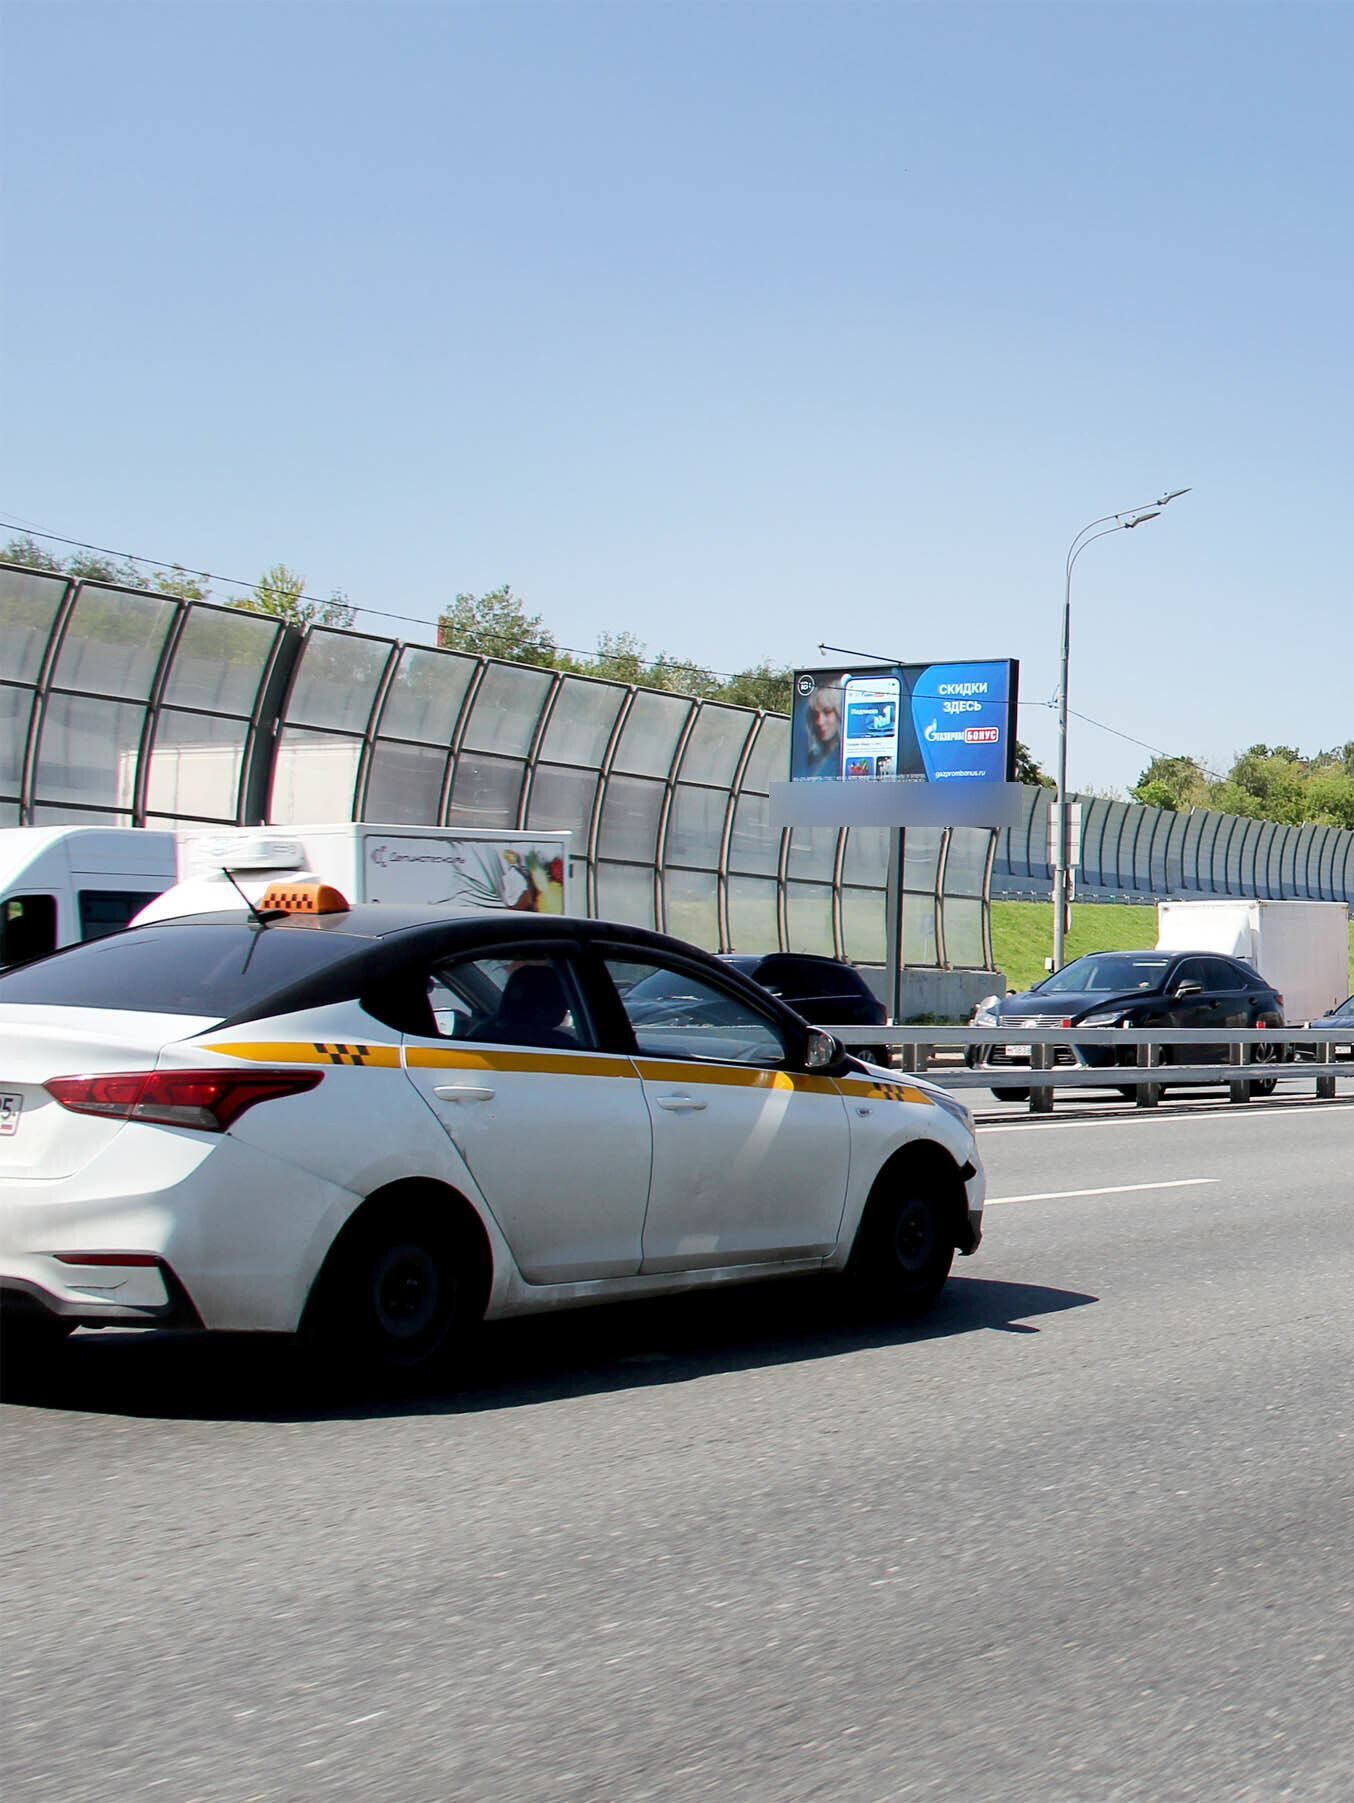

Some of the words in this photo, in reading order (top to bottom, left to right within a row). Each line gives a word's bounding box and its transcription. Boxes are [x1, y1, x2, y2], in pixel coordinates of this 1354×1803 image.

[939, 682, 988, 697] СКИДКИ
[943, 700, 982, 715] ЗДЕСЬ
[967, 730, 996, 740] БОНУС
[935, 770, 986, 779] gazprombonus.ru
